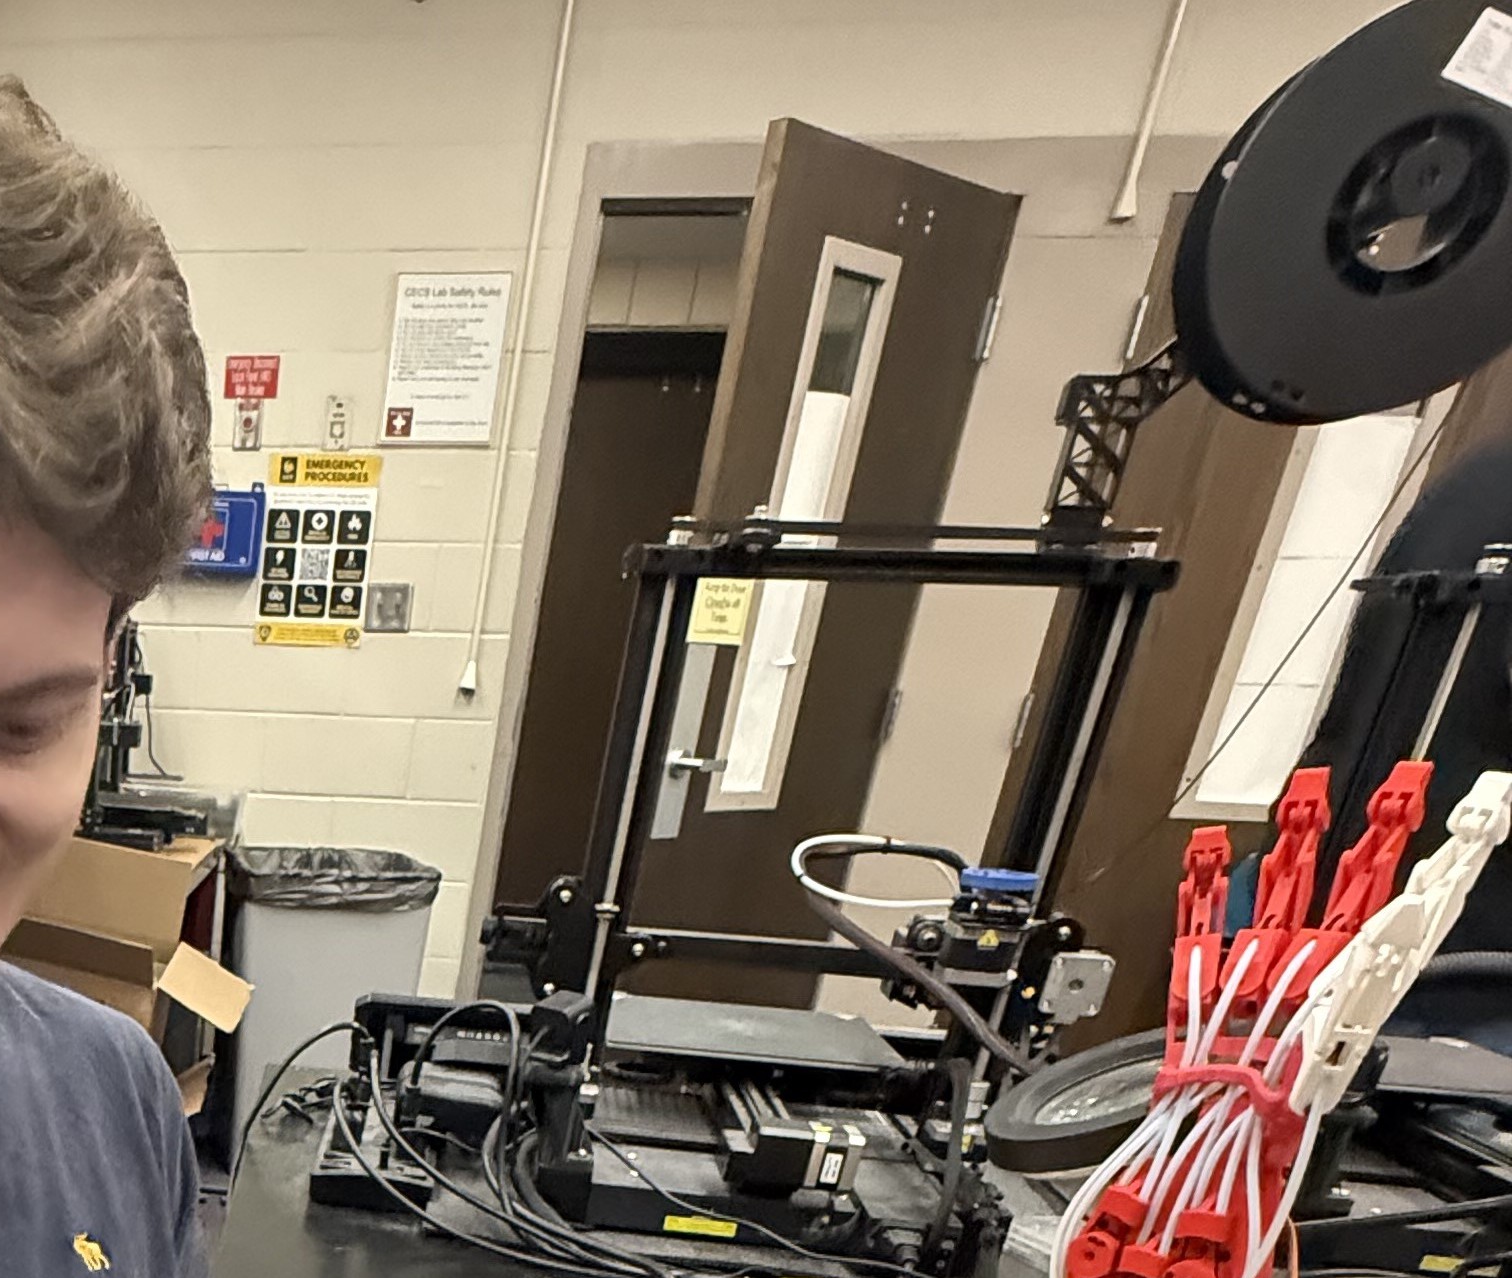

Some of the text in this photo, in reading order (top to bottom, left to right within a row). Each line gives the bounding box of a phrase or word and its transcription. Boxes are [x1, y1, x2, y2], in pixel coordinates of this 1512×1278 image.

[432, 287, 448, 297] Lab
[306, 459, 366, 470] EMERGENCY
[304, 471, 369, 482] PROCEDURES
[209, 548, 225, 561] AID
